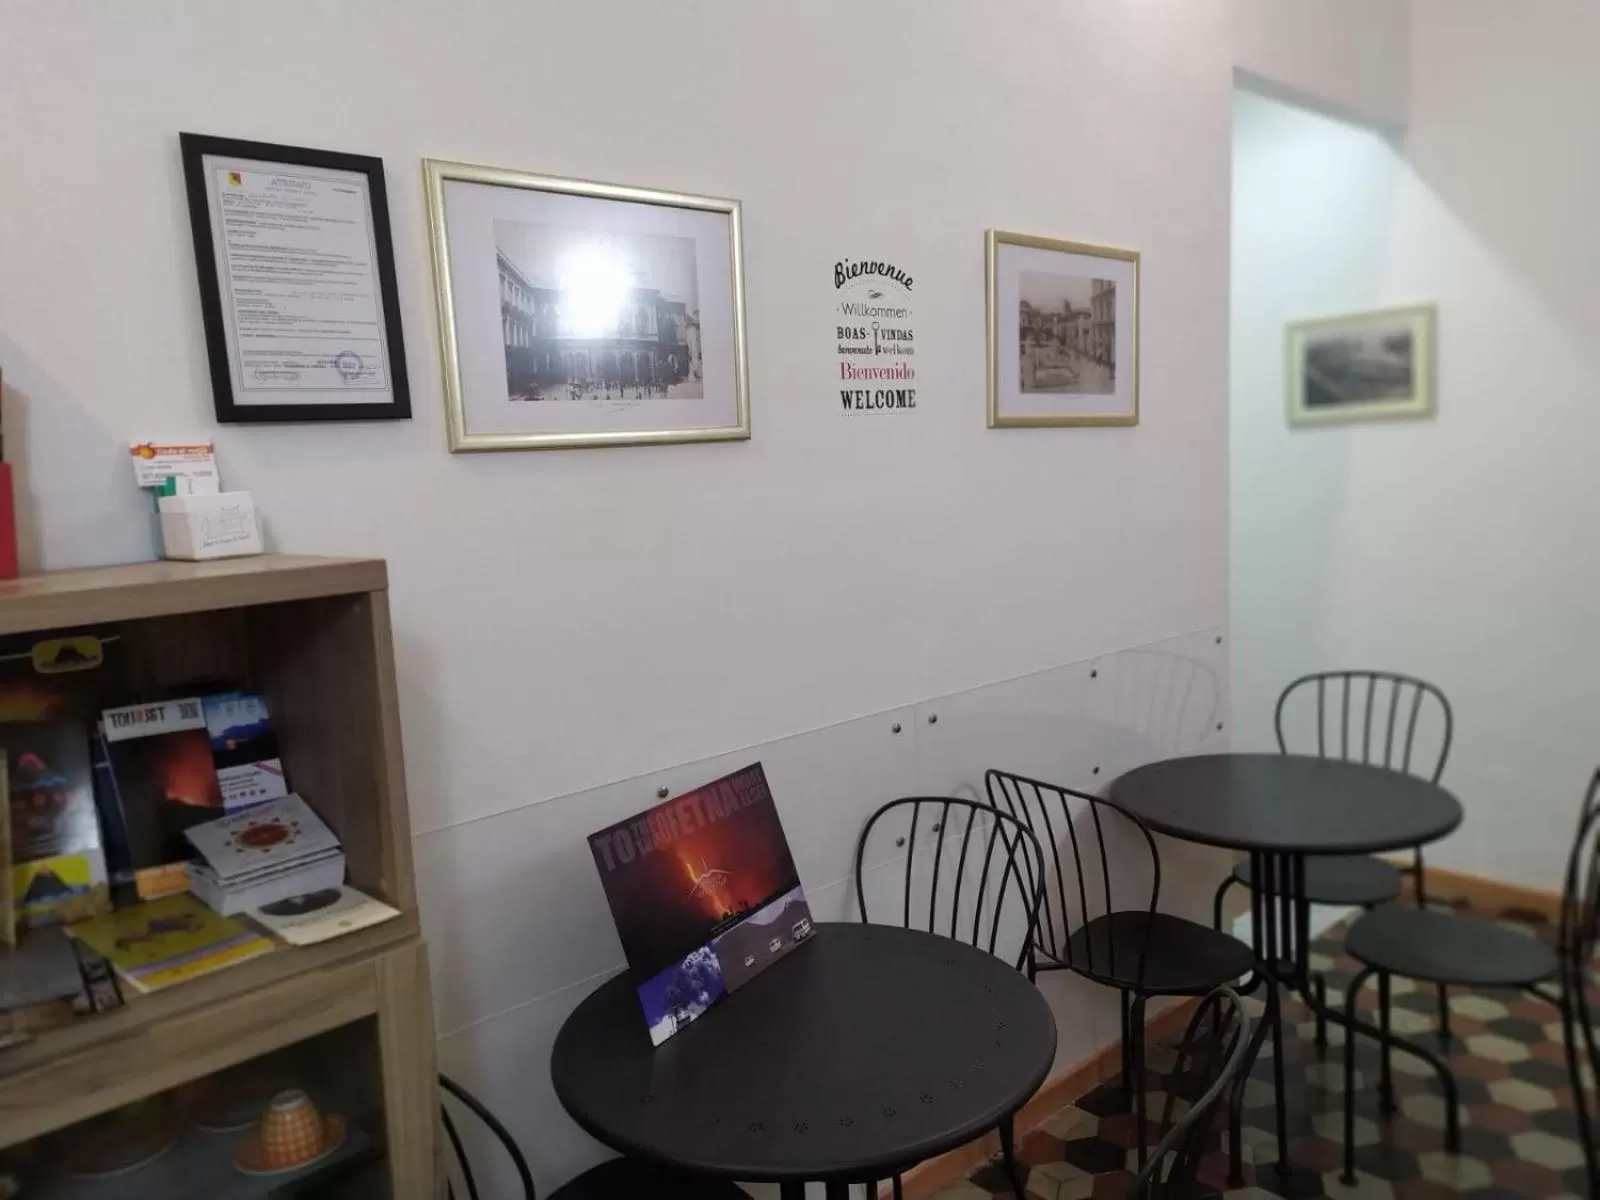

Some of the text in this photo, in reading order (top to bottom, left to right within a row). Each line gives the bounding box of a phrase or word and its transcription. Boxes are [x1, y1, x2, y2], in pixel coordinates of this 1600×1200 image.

[834, 258, 914, 291] Bienvenue
[841, 303, 907, 319] Willkommen
[881, 329, 914, 341] VINDAS
[883, 344, 914, 356] welkom
[840, 362, 915, 380] Bienvenido
[840, 389, 916, 409] WELCOME
[675, 780, 741, 834] ETNA
